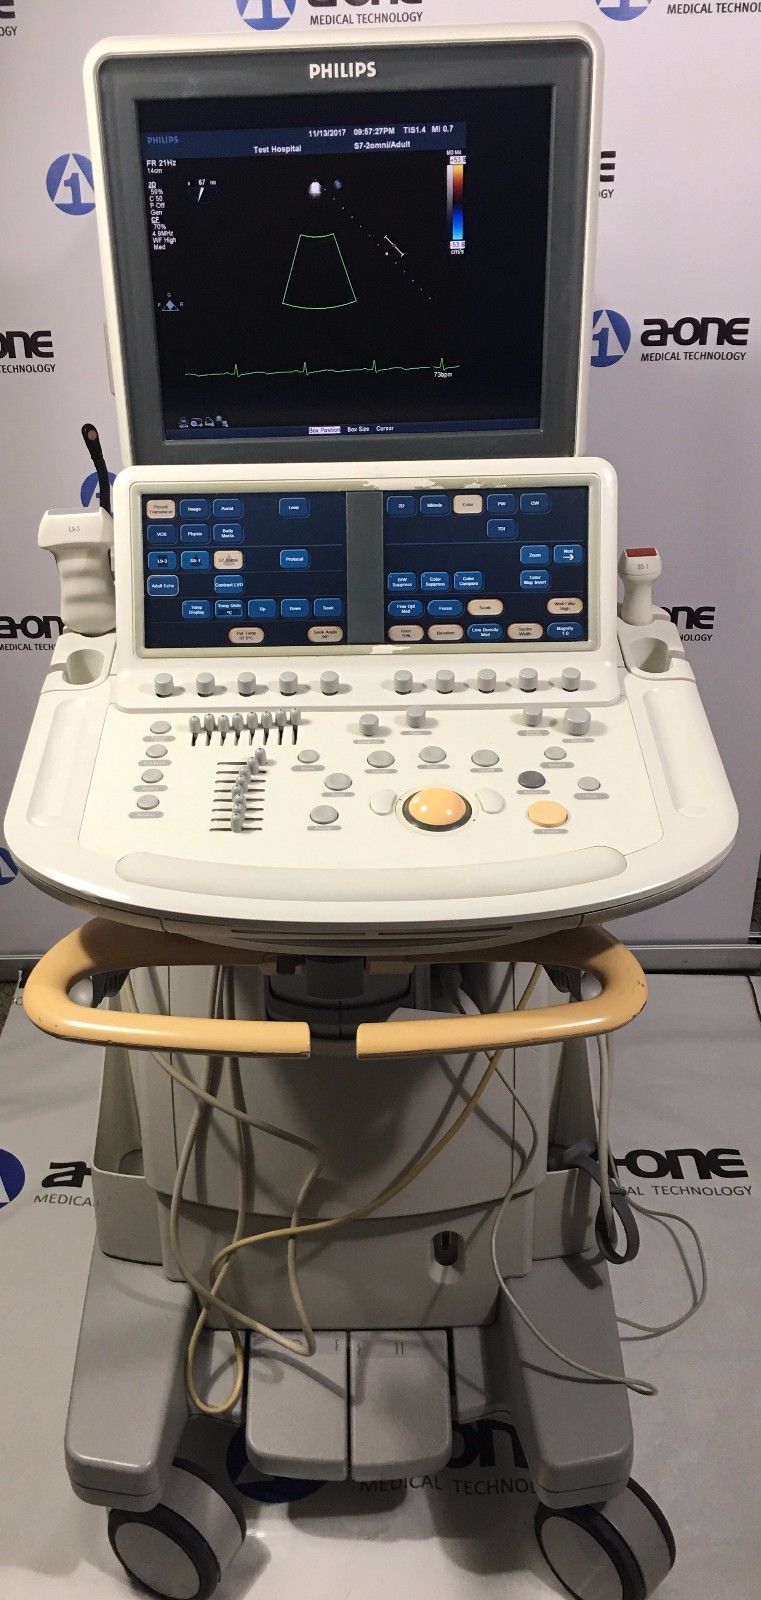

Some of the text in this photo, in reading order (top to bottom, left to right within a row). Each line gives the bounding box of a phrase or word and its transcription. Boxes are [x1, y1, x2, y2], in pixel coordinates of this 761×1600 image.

[667, 4, 713, 14] MEDICAL
[310, 12, 423, 25] MEDICAL TECHNOLOGY
[309, 62, 377, 79] PHILIPS
[308, 129, 346, 137] 11/13/2017
[353, 127, 395, 136] 09:57:27PM
[147, 136, 179, 144] PHILIPS
[253, 145, 302, 154] Test Hospital
[158, 159, 177, 167] 21Hz
[641, 351, 746, 362] MEDICAL TECHNOLOGY
[651, 1185, 752, 1197] TECHNOLOGY
